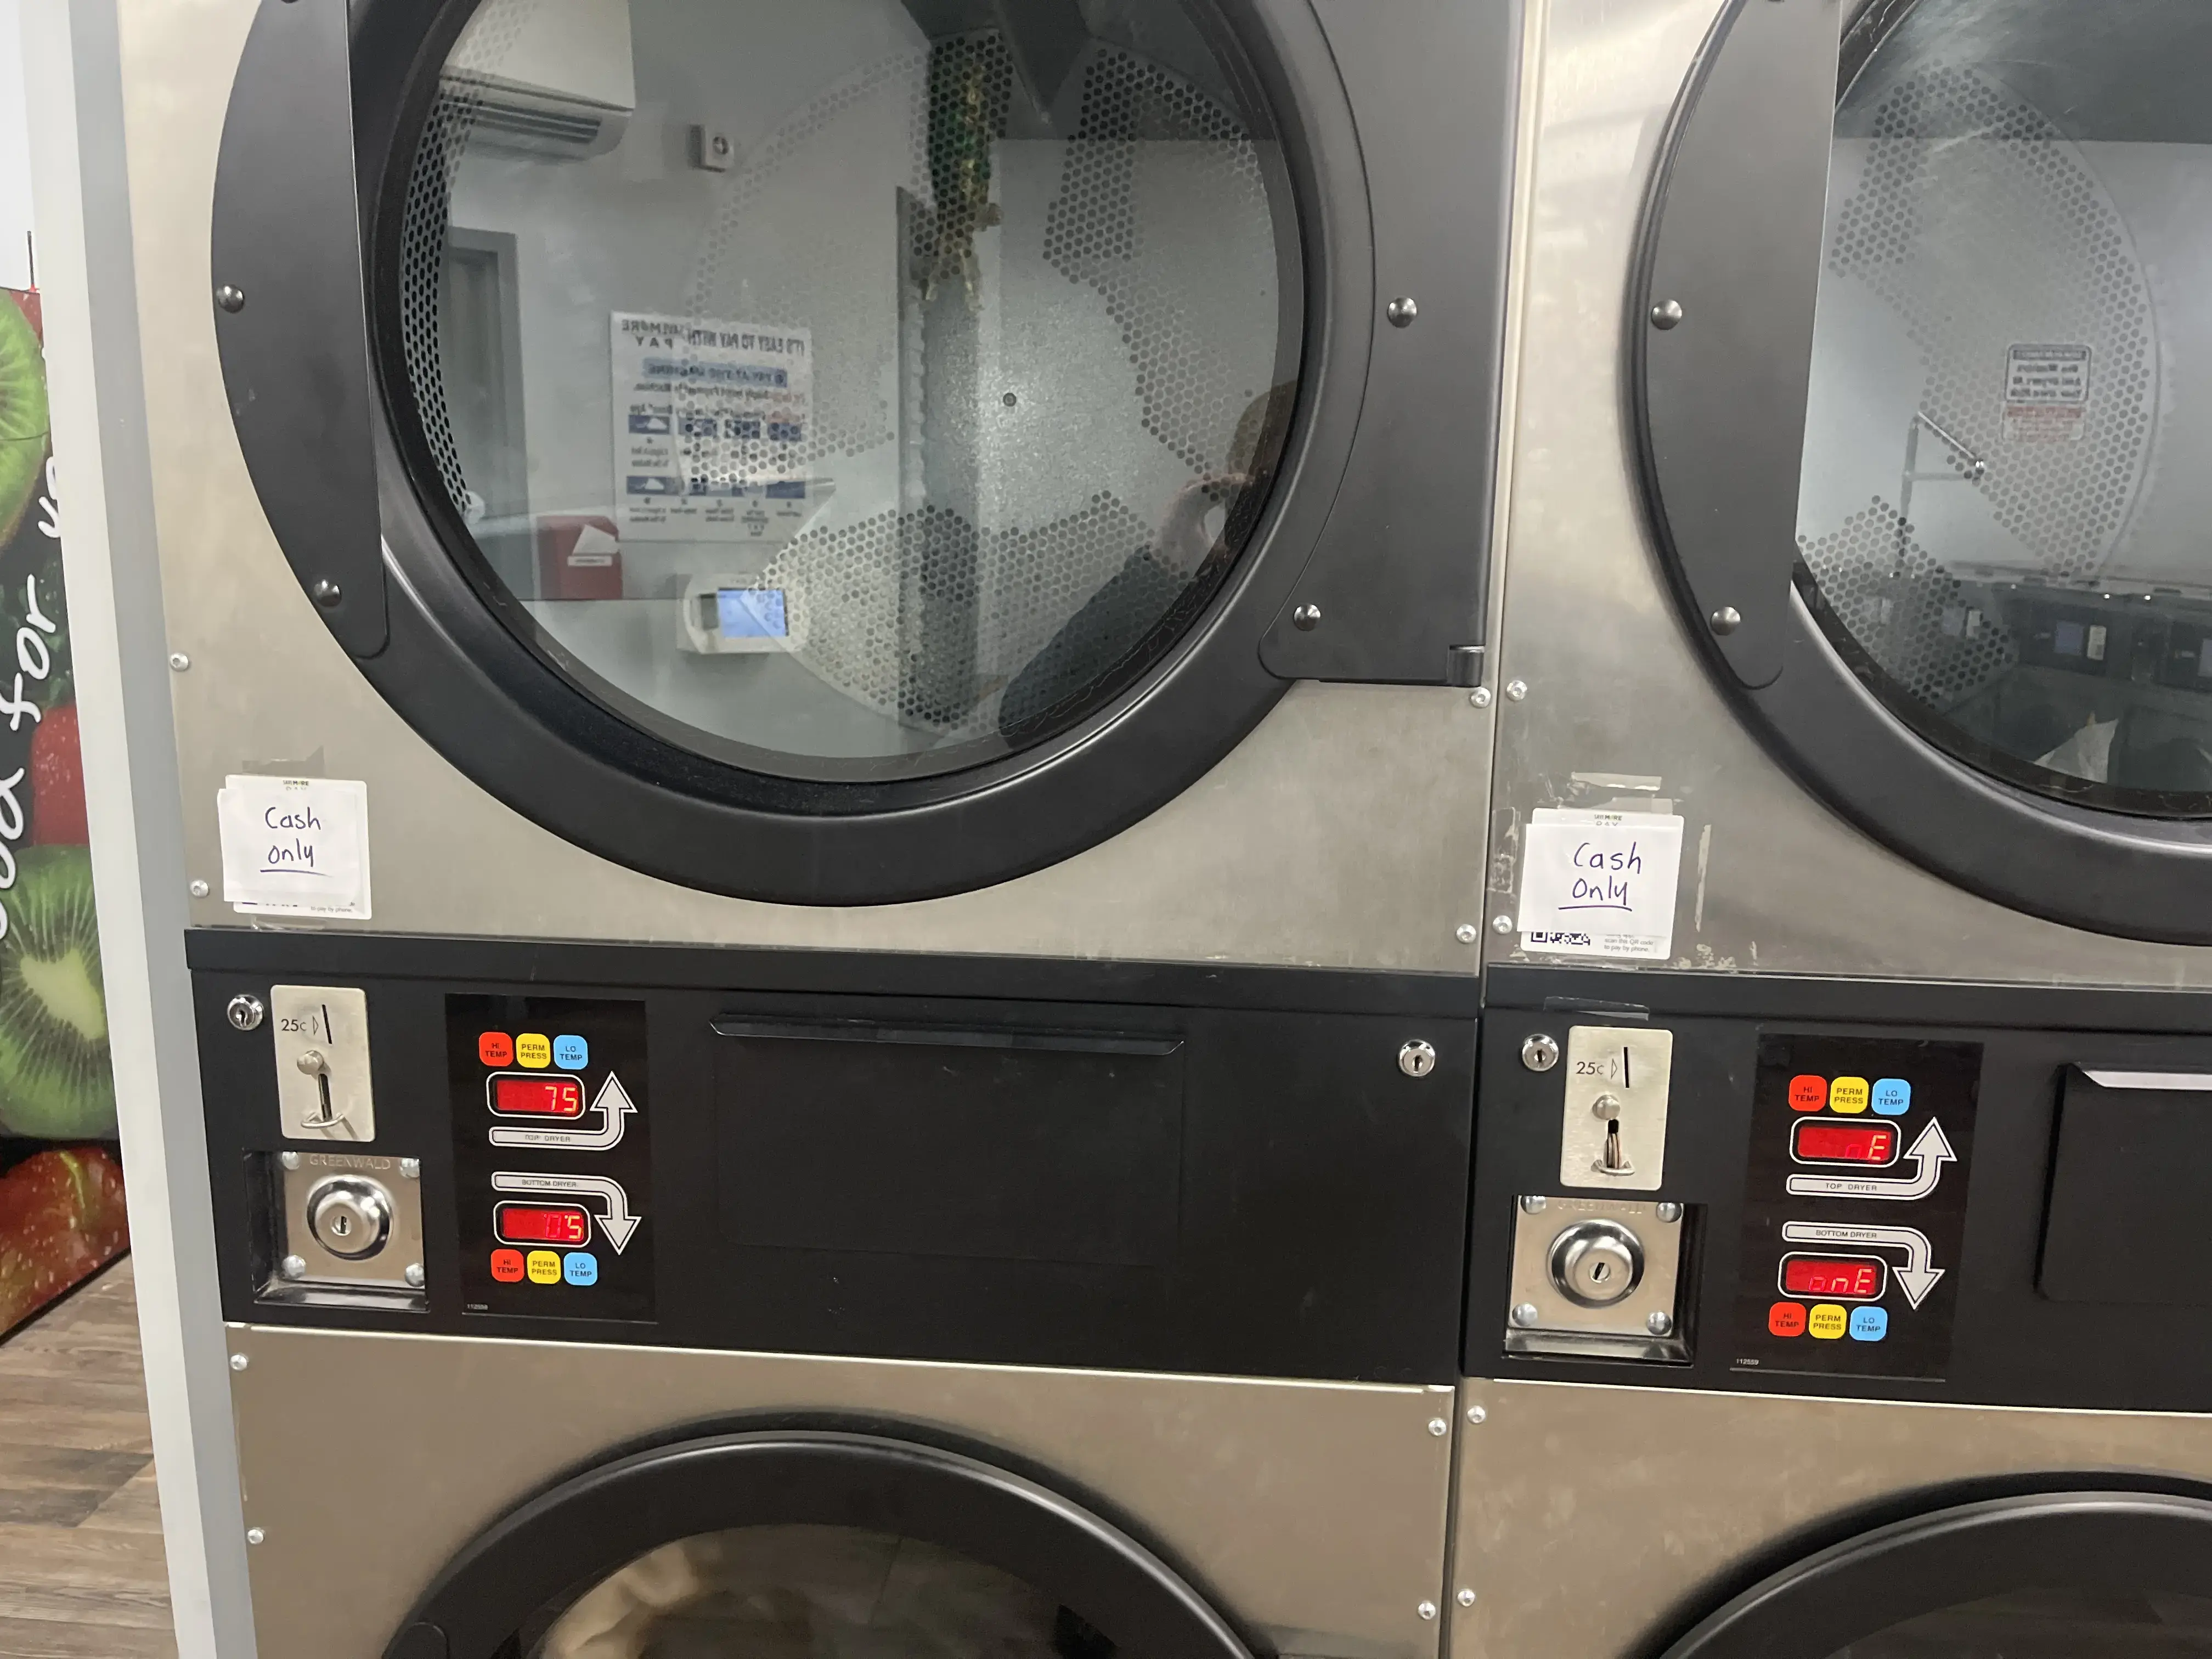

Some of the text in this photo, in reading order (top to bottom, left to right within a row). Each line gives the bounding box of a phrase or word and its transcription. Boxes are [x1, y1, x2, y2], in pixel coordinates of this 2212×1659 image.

[0, 573, 56, 731] for
[265, 806, 321, 830] Cash
[1573, 841, 1641, 874] Cash
[485, 1050, 507, 1058] TEMP
[521, 1051, 547, 1059] PRESS
[1836, 1087, 1863, 1096] PERM
[544, 1085, 578, 1112] 75
[1795, 1094, 1820, 1102] TEMP
[1834, 1096, 1864, 1104] PRESS
[1878, 1098, 1904, 1106] TEMP
[309, 1154, 391, 1170] GREENWALD
[1848, 1183, 1877, 1192] DRYER
[1815, 1229, 1848, 1237] BOTTOM
[531, 1268, 558, 1276] PRESS
[1813, 1322, 1842, 1330] PRESS
